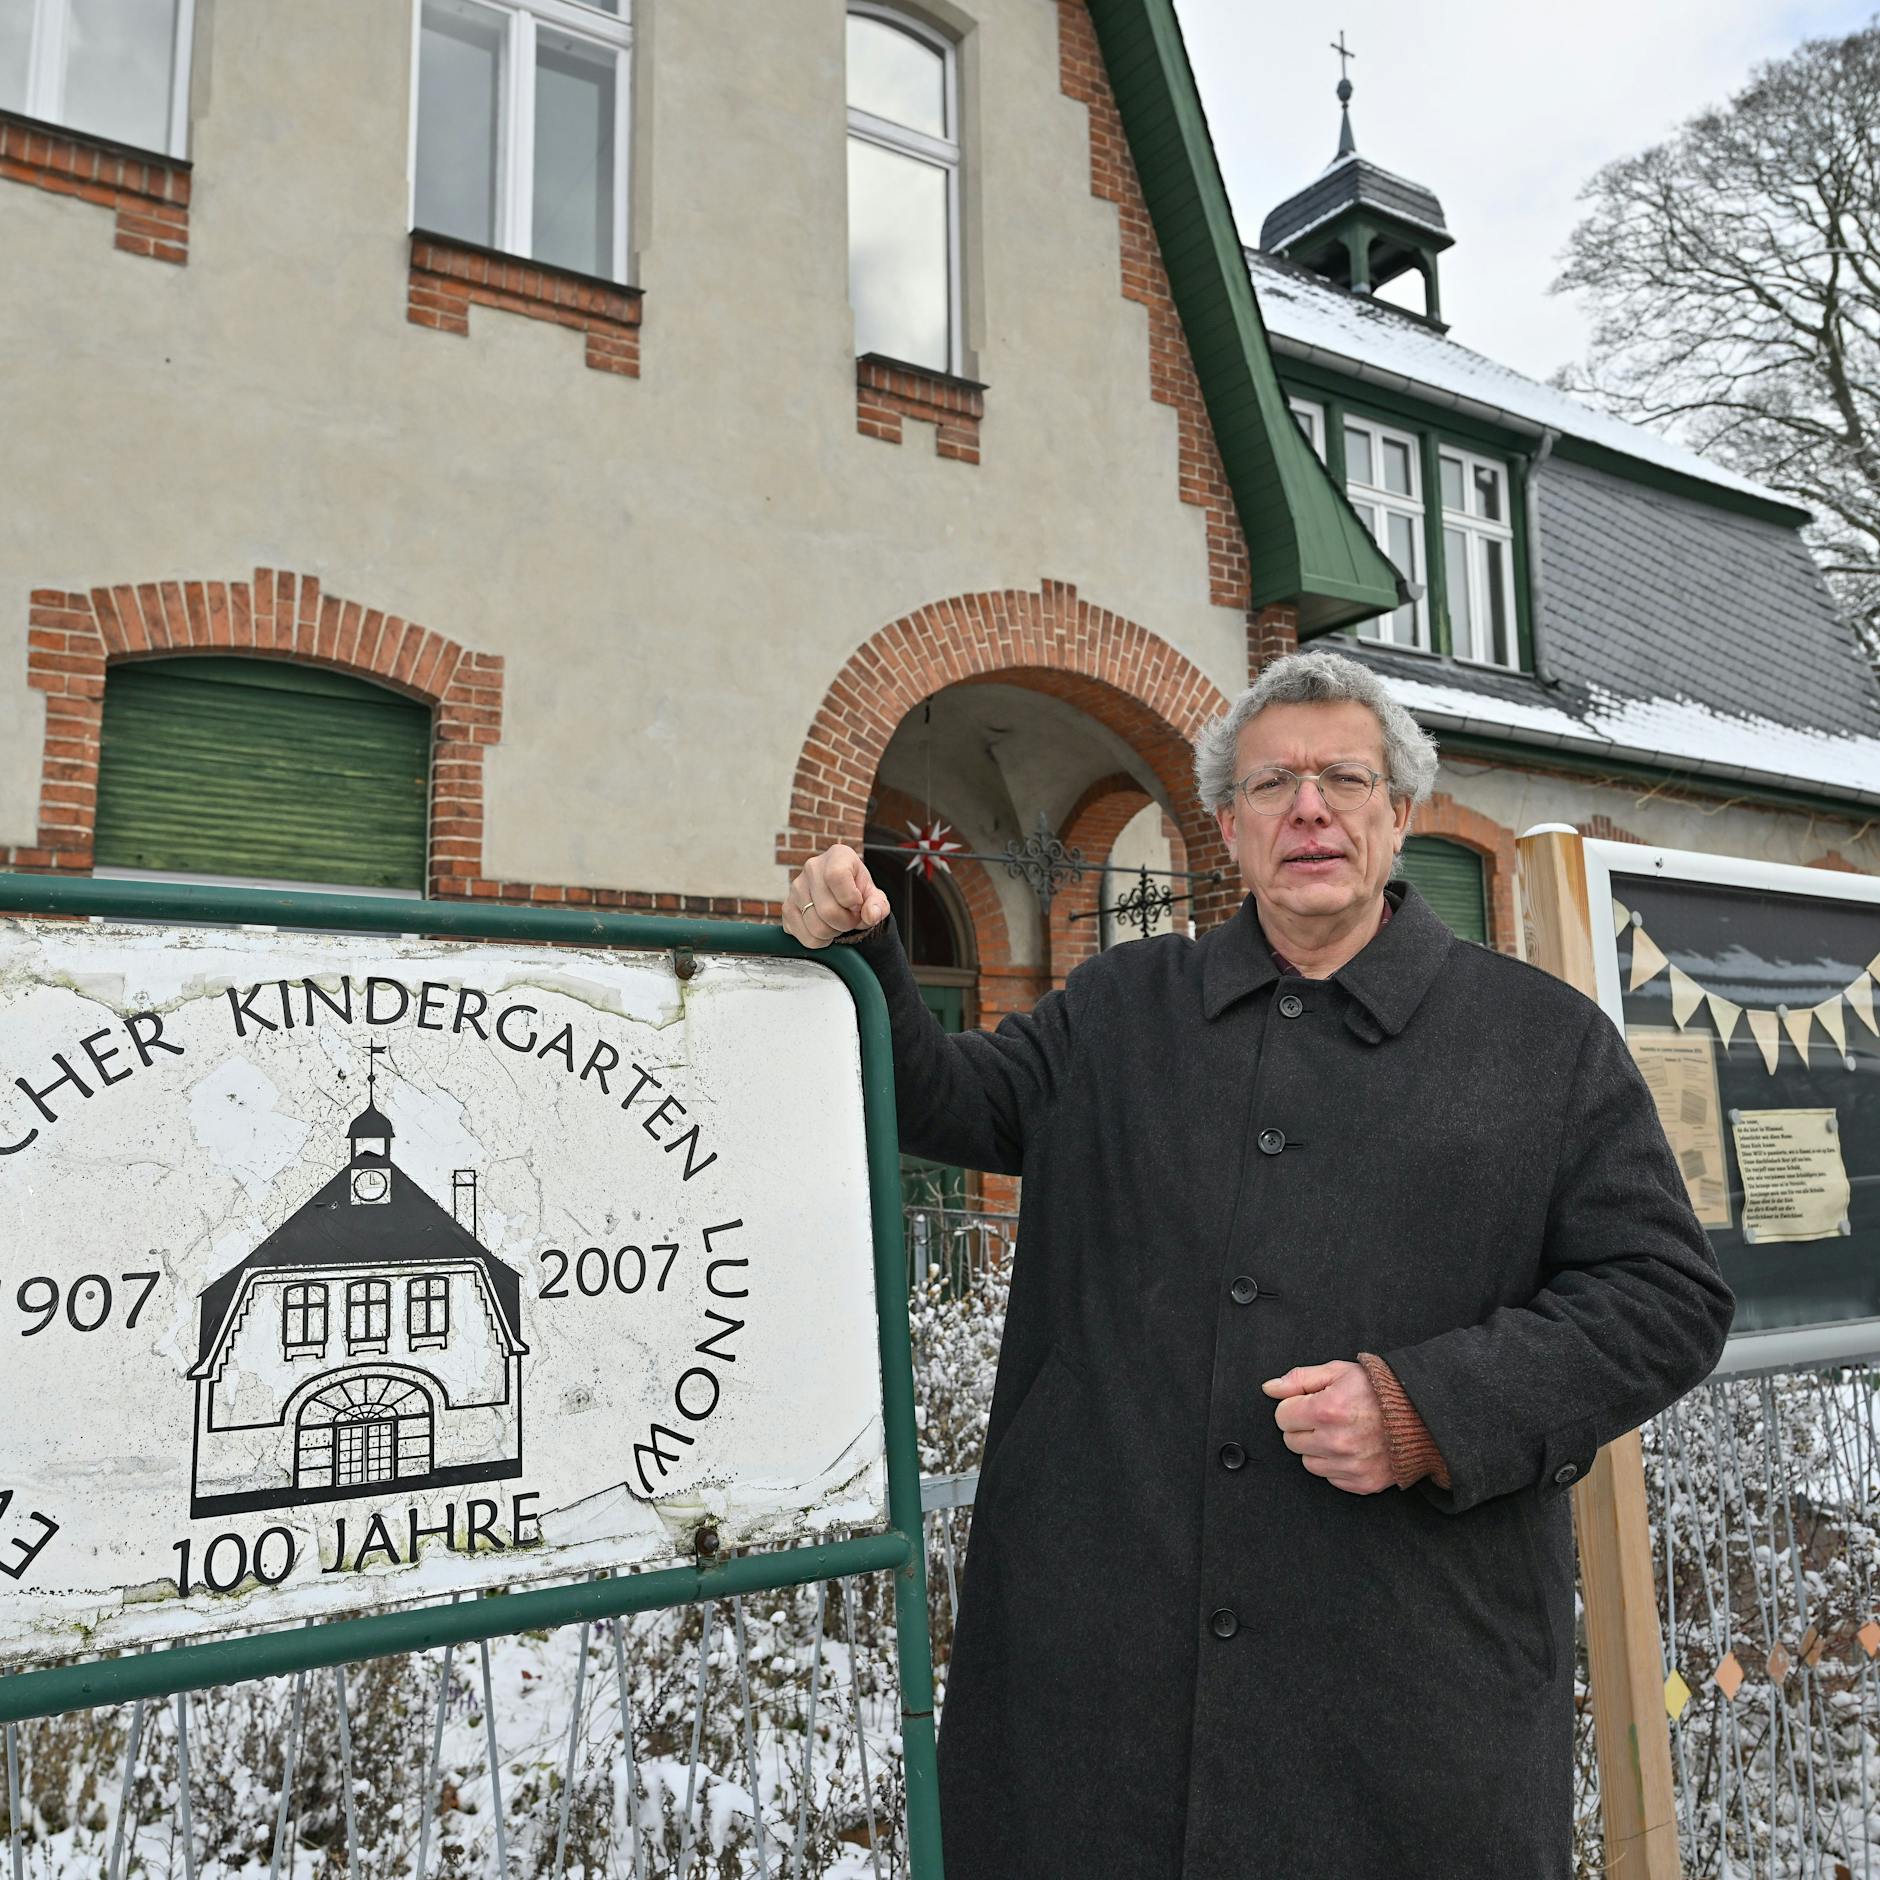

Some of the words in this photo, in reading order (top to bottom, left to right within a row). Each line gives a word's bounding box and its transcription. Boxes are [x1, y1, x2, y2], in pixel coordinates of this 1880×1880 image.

[226, 975, 719, 1183] KINDERGARTEN
[633, 1218, 750, 1495] LUNOW
[0, 1271, 161, 1337] 907
[538, 1242, 681, 1300] 2007
[168, 1526, 297, 1599] 100
[320, 1491, 544, 1574] JAHRE
